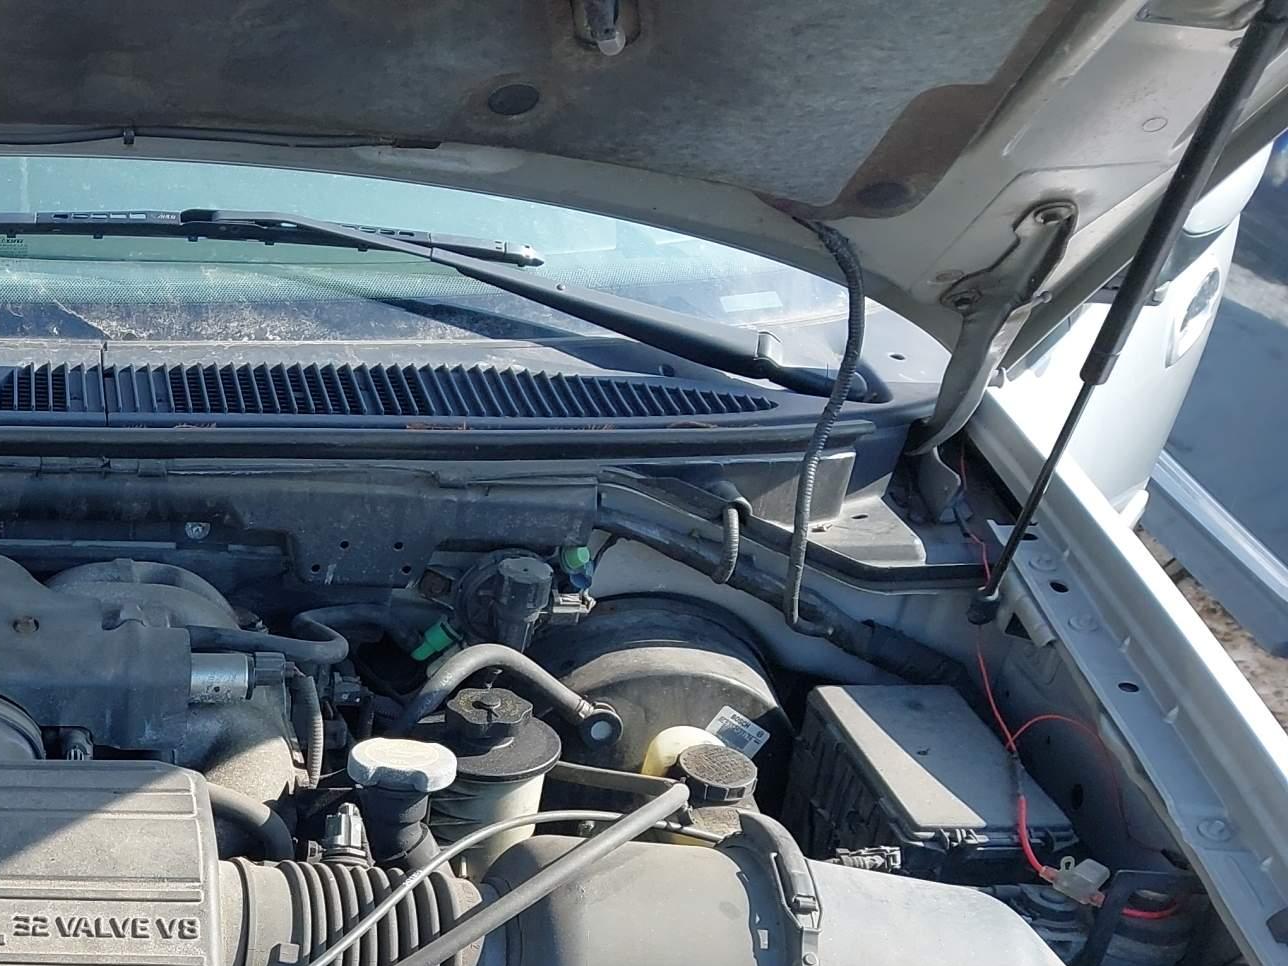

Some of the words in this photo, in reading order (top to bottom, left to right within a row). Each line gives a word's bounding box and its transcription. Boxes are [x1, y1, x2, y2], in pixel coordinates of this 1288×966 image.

[730, 713, 752, 730] BOSCH
[11, 914, 50, 938] 32
[54, 916, 150, 939] VALVE
[155, 917, 200, 940] V8
